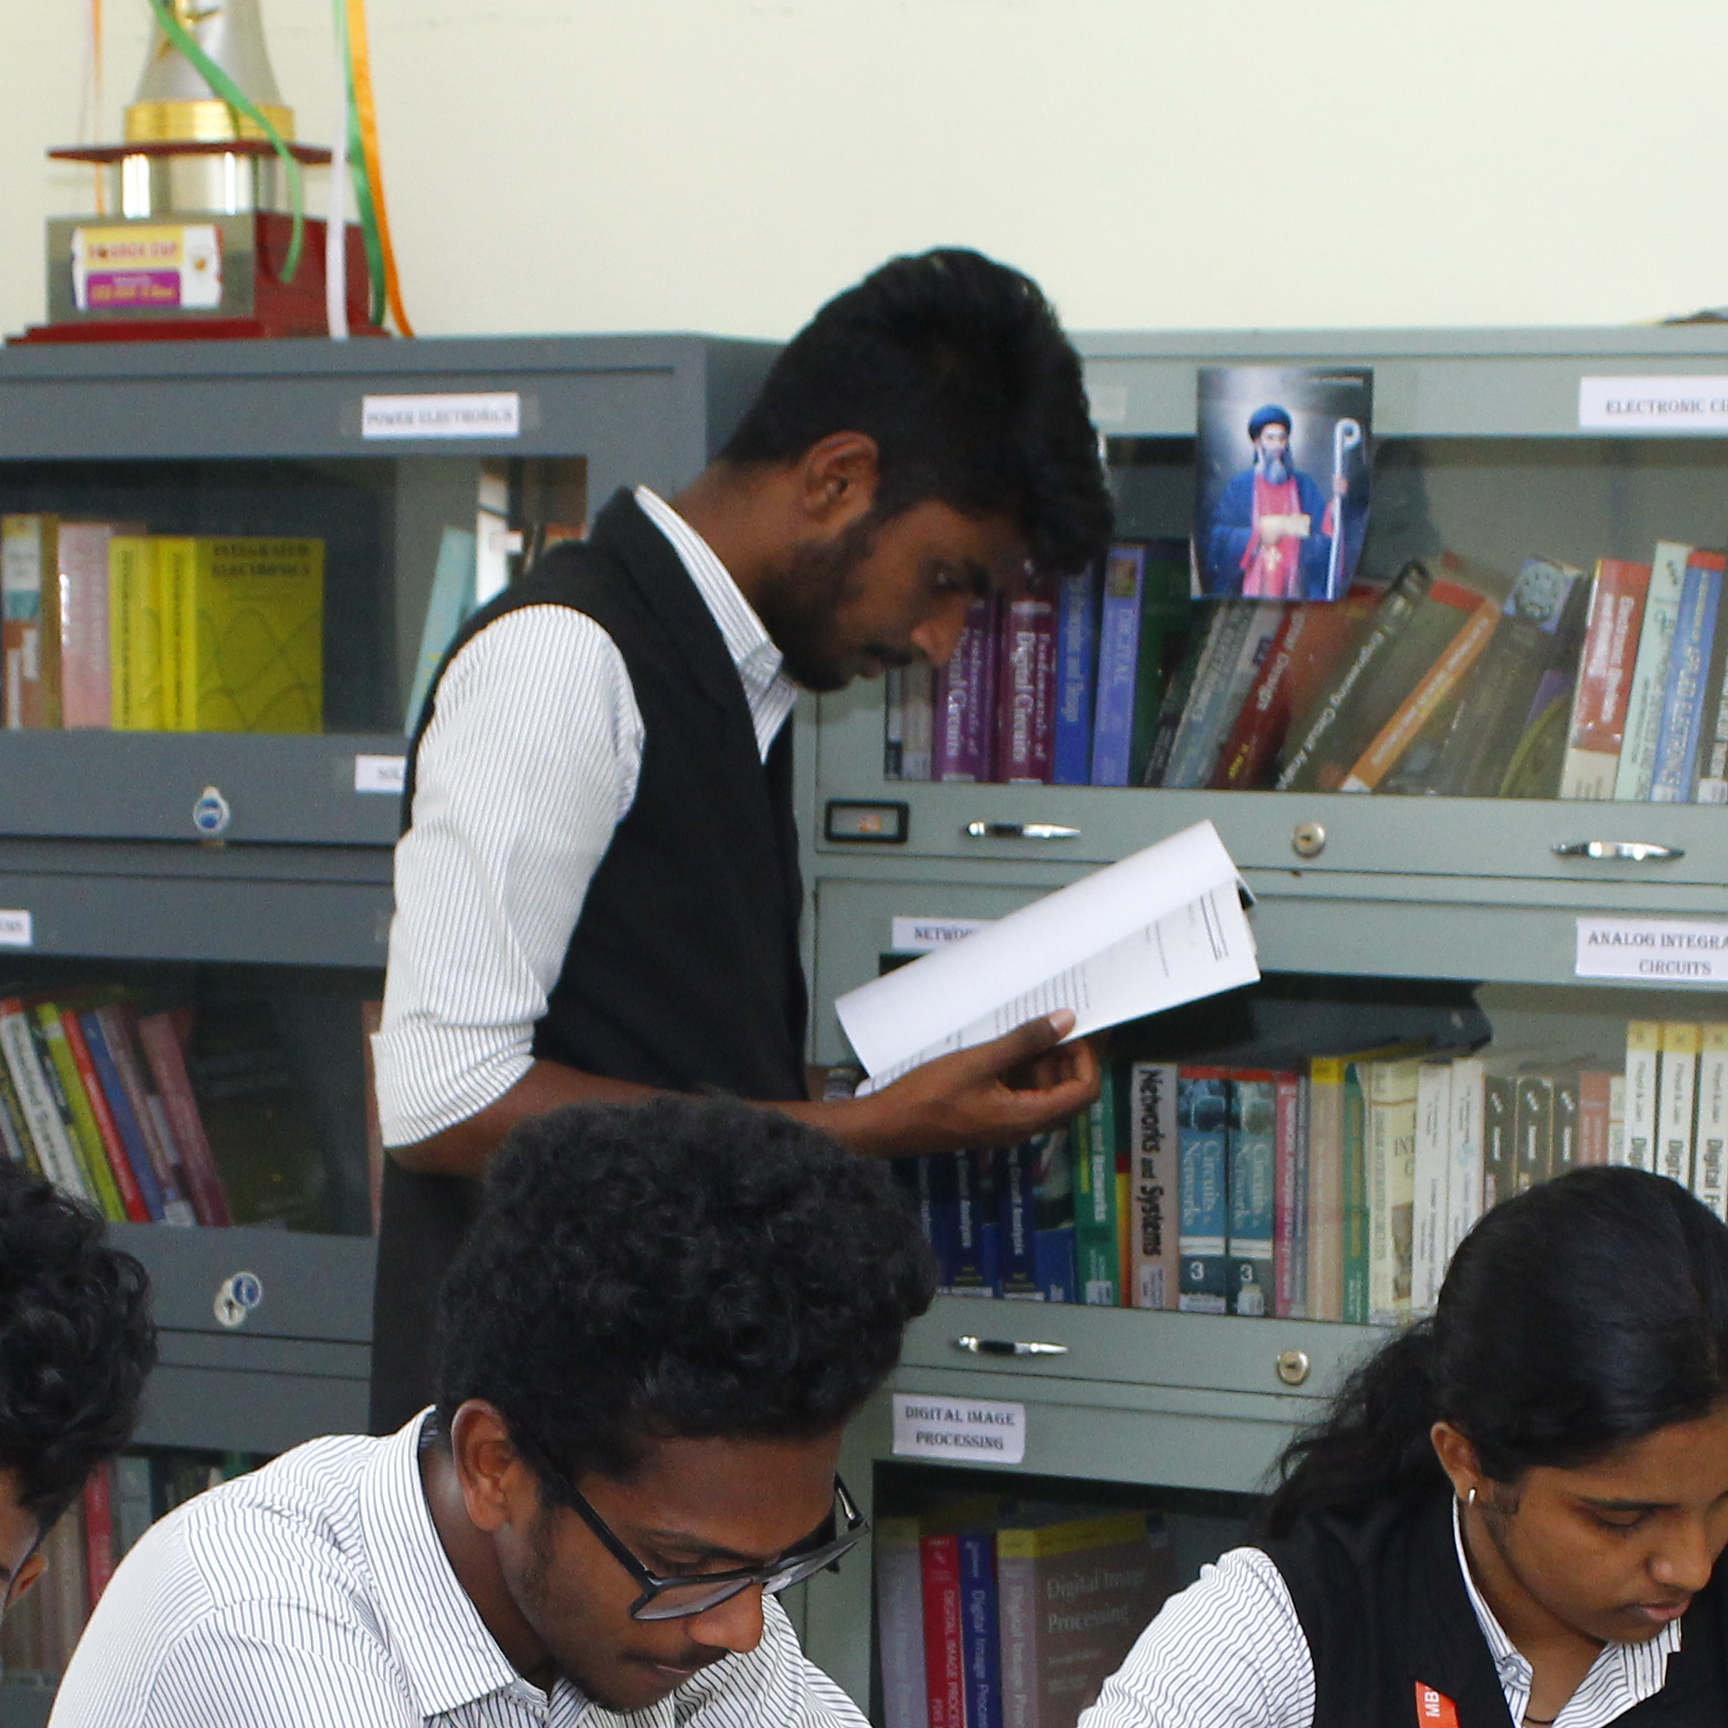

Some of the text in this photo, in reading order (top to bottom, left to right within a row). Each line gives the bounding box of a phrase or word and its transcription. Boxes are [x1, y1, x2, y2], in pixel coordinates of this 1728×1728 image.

[1606, 398, 1705, 414] ELECTRONIC
[1256, 652, 1289, 712] Design
[1329, 629, 1385, 707] Engineering
[1010, 631, 1037, 763] Digital Circuits
[1663, 643, 1700, 786] APPLIED ELECTRONICS
[946, 688, 967, 758] Circuits
[1587, 930, 1656, 946] ANALOG
[1638, 959, 1712, 976] CIRCUITS
[1134, 1067, 1167, 1257] Networks and Systems
[1181, 1142, 1199, 1226] Networks
[1201, 1140, 1221, 1211] Circuits
[1250, 1141, 1269, 1214] Circuits
[1703, 1138, 1723, 1189] Digital
[1091, 1154, 1108, 1223] Networks
[1189, 1262, 1205, 1281] 3
[1240, 1263, 1254, 1283] 3
[905, 1405, 1015, 1426] DIGITAL IMAGE
[915, 1431, 1004, 1450] PROCESSING
[1047, 1572, 1095, 1601] Digital
[943, 1589, 956, 1635] DIGITAL
[970, 1589, 986, 1633] Digital
[1047, 1604, 1130, 1634] Processing
[945, 1637, 958, 1679] IMAGE
[972, 1636, 987, 1680] Image
